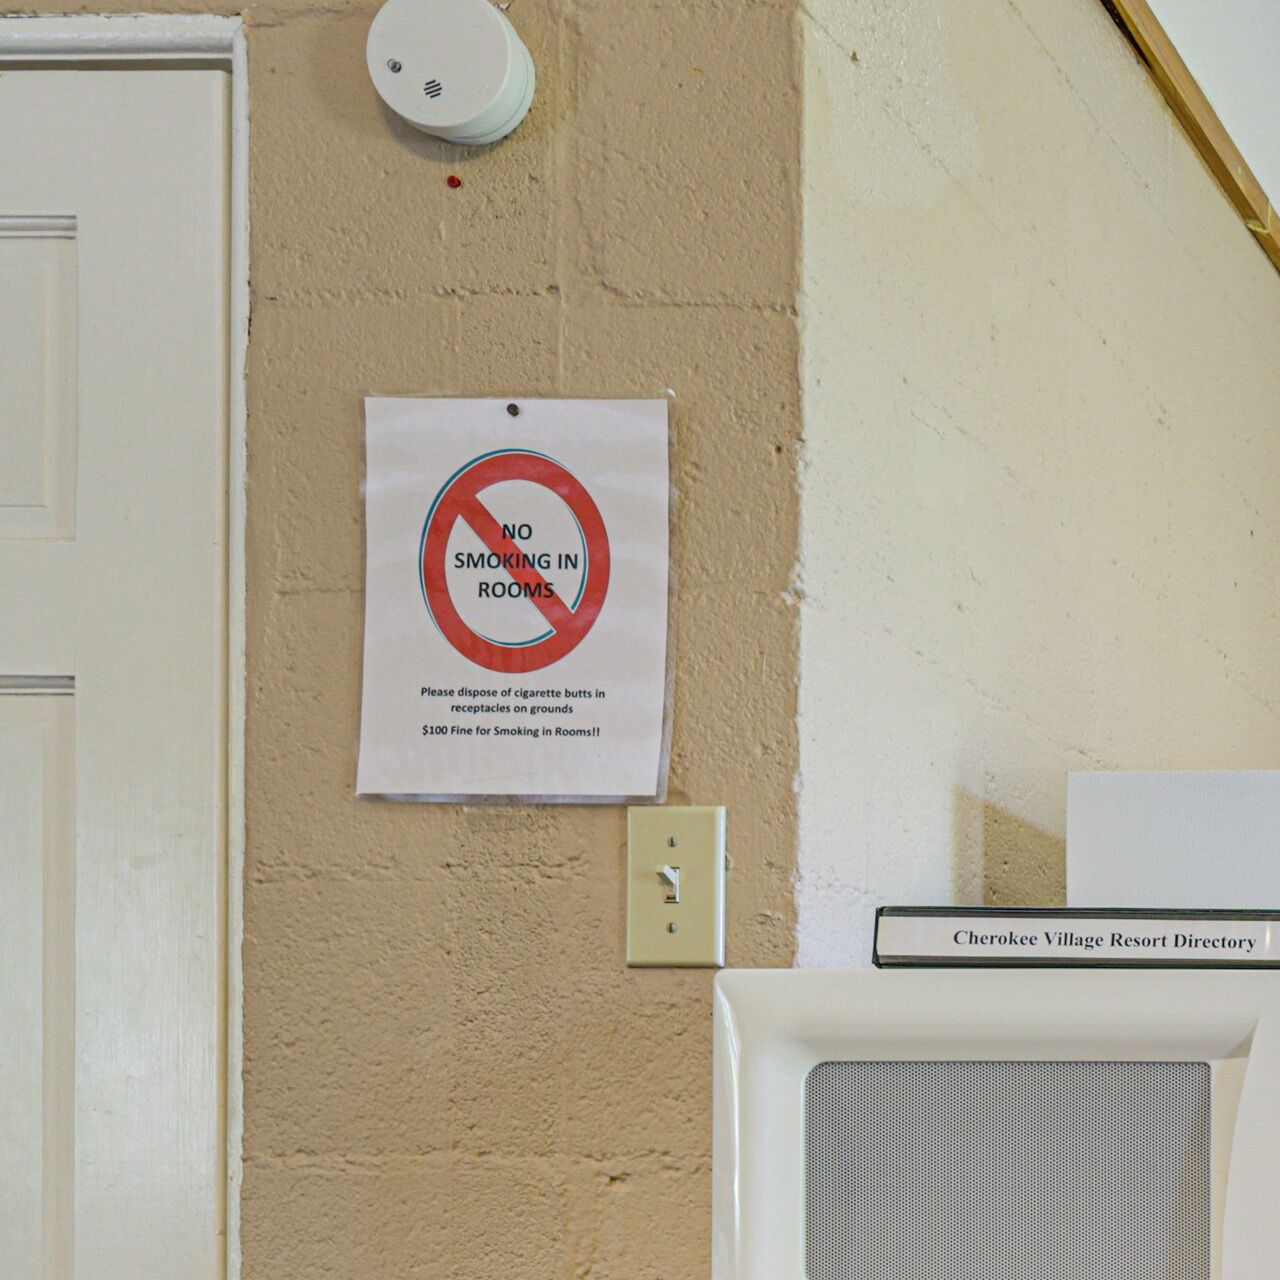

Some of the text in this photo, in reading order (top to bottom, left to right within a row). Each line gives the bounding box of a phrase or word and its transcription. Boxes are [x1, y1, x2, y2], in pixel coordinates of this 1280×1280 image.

[502, 524, 533, 540] NO
[454, 552, 579, 570] SMOKING IN
[478, 581, 555, 599] ROOMS
[420, 687, 605, 702] Please dispose of cigarette butts in
[450, 702, 573, 717] receptacles on grounds
[422, 724, 600, 740] $100 Fine for Smoking in Rooms!!
[953, 930, 1257, 952] Cherokee Village Resort Directory
